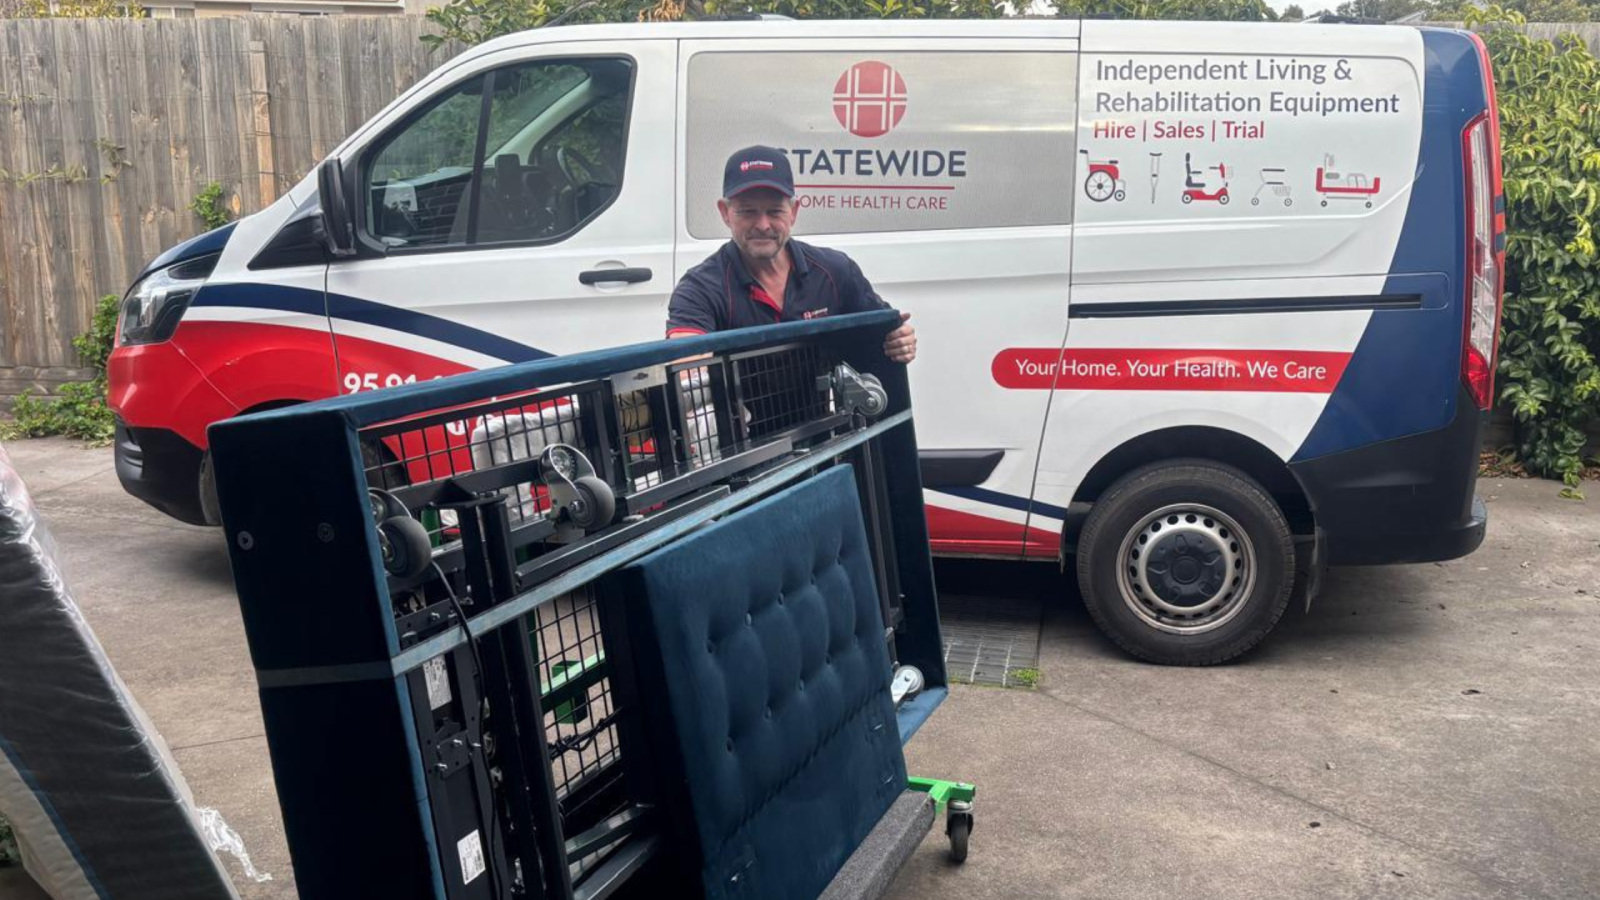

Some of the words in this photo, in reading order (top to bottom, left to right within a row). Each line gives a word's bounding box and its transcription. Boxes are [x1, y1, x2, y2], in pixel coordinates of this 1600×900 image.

[1096, 59, 1248, 85] Independent
[1255, 58, 1326, 84] Living
[1334, 59, 1353, 81] &
[1096, 91, 1261, 113] Rehabilitation
[1269, 91, 1400, 117] Equipment
[1094, 121, 1136, 139] Hire
[1153, 120, 1205, 139] Sales
[1222, 121, 1265, 139] Trial
[778, 149, 967, 177] TATEWIDE
[796, 194, 836, 208] OME
[841, 195, 901, 209] HEALTH
[906, 196, 948, 210] CARE
[1015, 358, 1056, 377] Your
[1061, 359, 1121, 377] Home.
[1126, 359, 1169, 378] Your
[1174, 360, 1241, 378] Health.
[1246, 361, 1279, 379] We
[1283, 361, 1327, 380] Care
